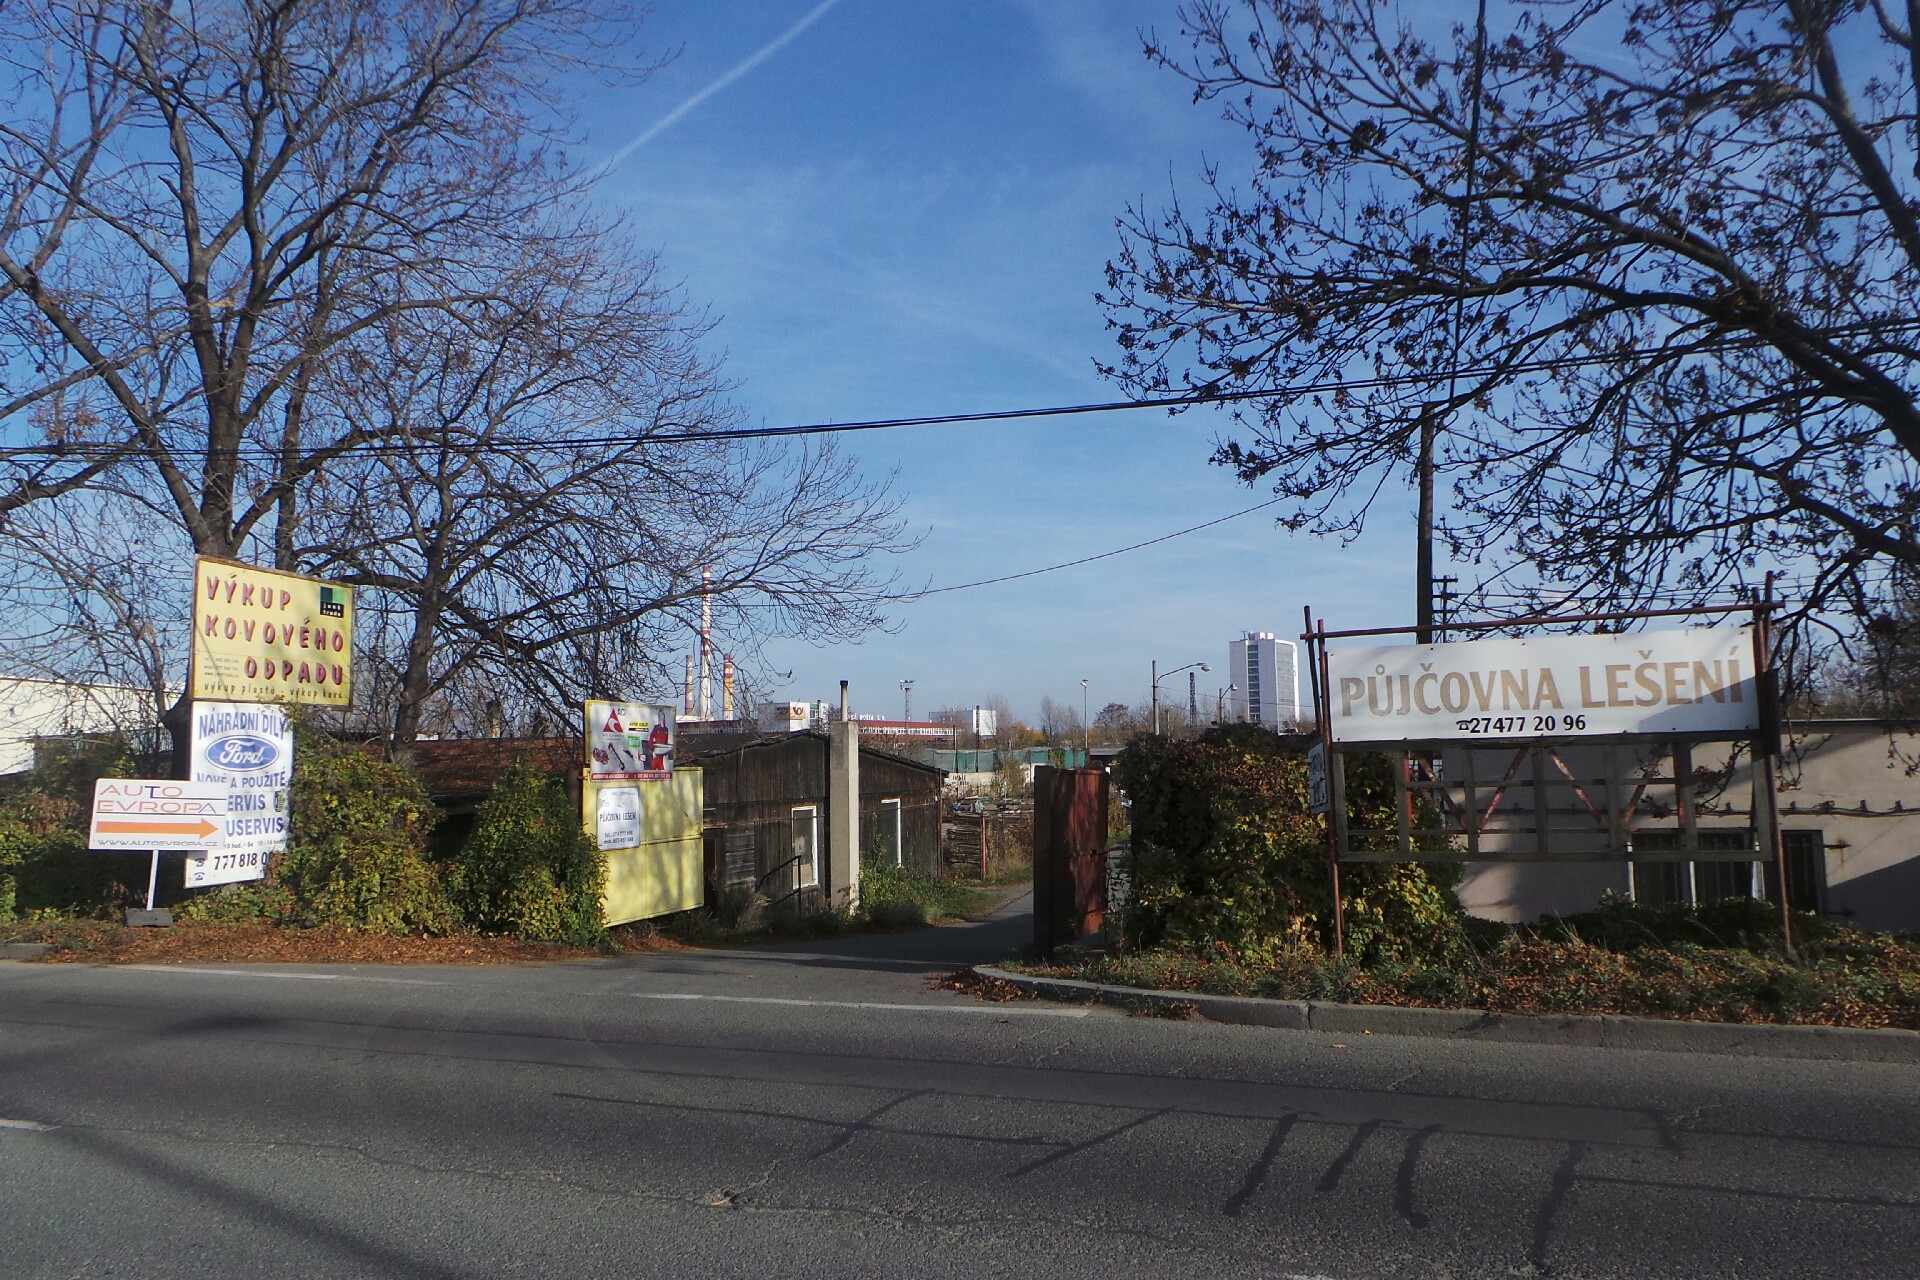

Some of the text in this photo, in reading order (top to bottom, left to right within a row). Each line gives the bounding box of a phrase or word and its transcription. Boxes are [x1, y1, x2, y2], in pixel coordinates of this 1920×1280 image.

[206, 571, 291, 612] VÝKUP
[205, 615, 344, 652] KOVOVÉHO
[244, 656, 343, 685] ODPADU
[1341, 646, 1744, 717] PŮJČOVNA LEŠENÍ
[204, 683, 236, 694] výkup
[290, 687, 318, 699] výkup
[199, 708, 286, 740] NÁHRADNÍ DÍLY
[1470, 714, 1586, 734] 27477 20 96
[219, 739, 265, 764] Ford
[231, 777, 237, 788] A
[242, 766, 286, 788] POUŽITÉ
[99, 784, 183, 798] AUTO
[97, 799, 217, 814] EVROPA
[227, 794, 265, 812] ERVIS
[226, 816, 284, 838] USERVIS
[214, 854, 237, 870] 777
[239, 853, 258, 867] 818
